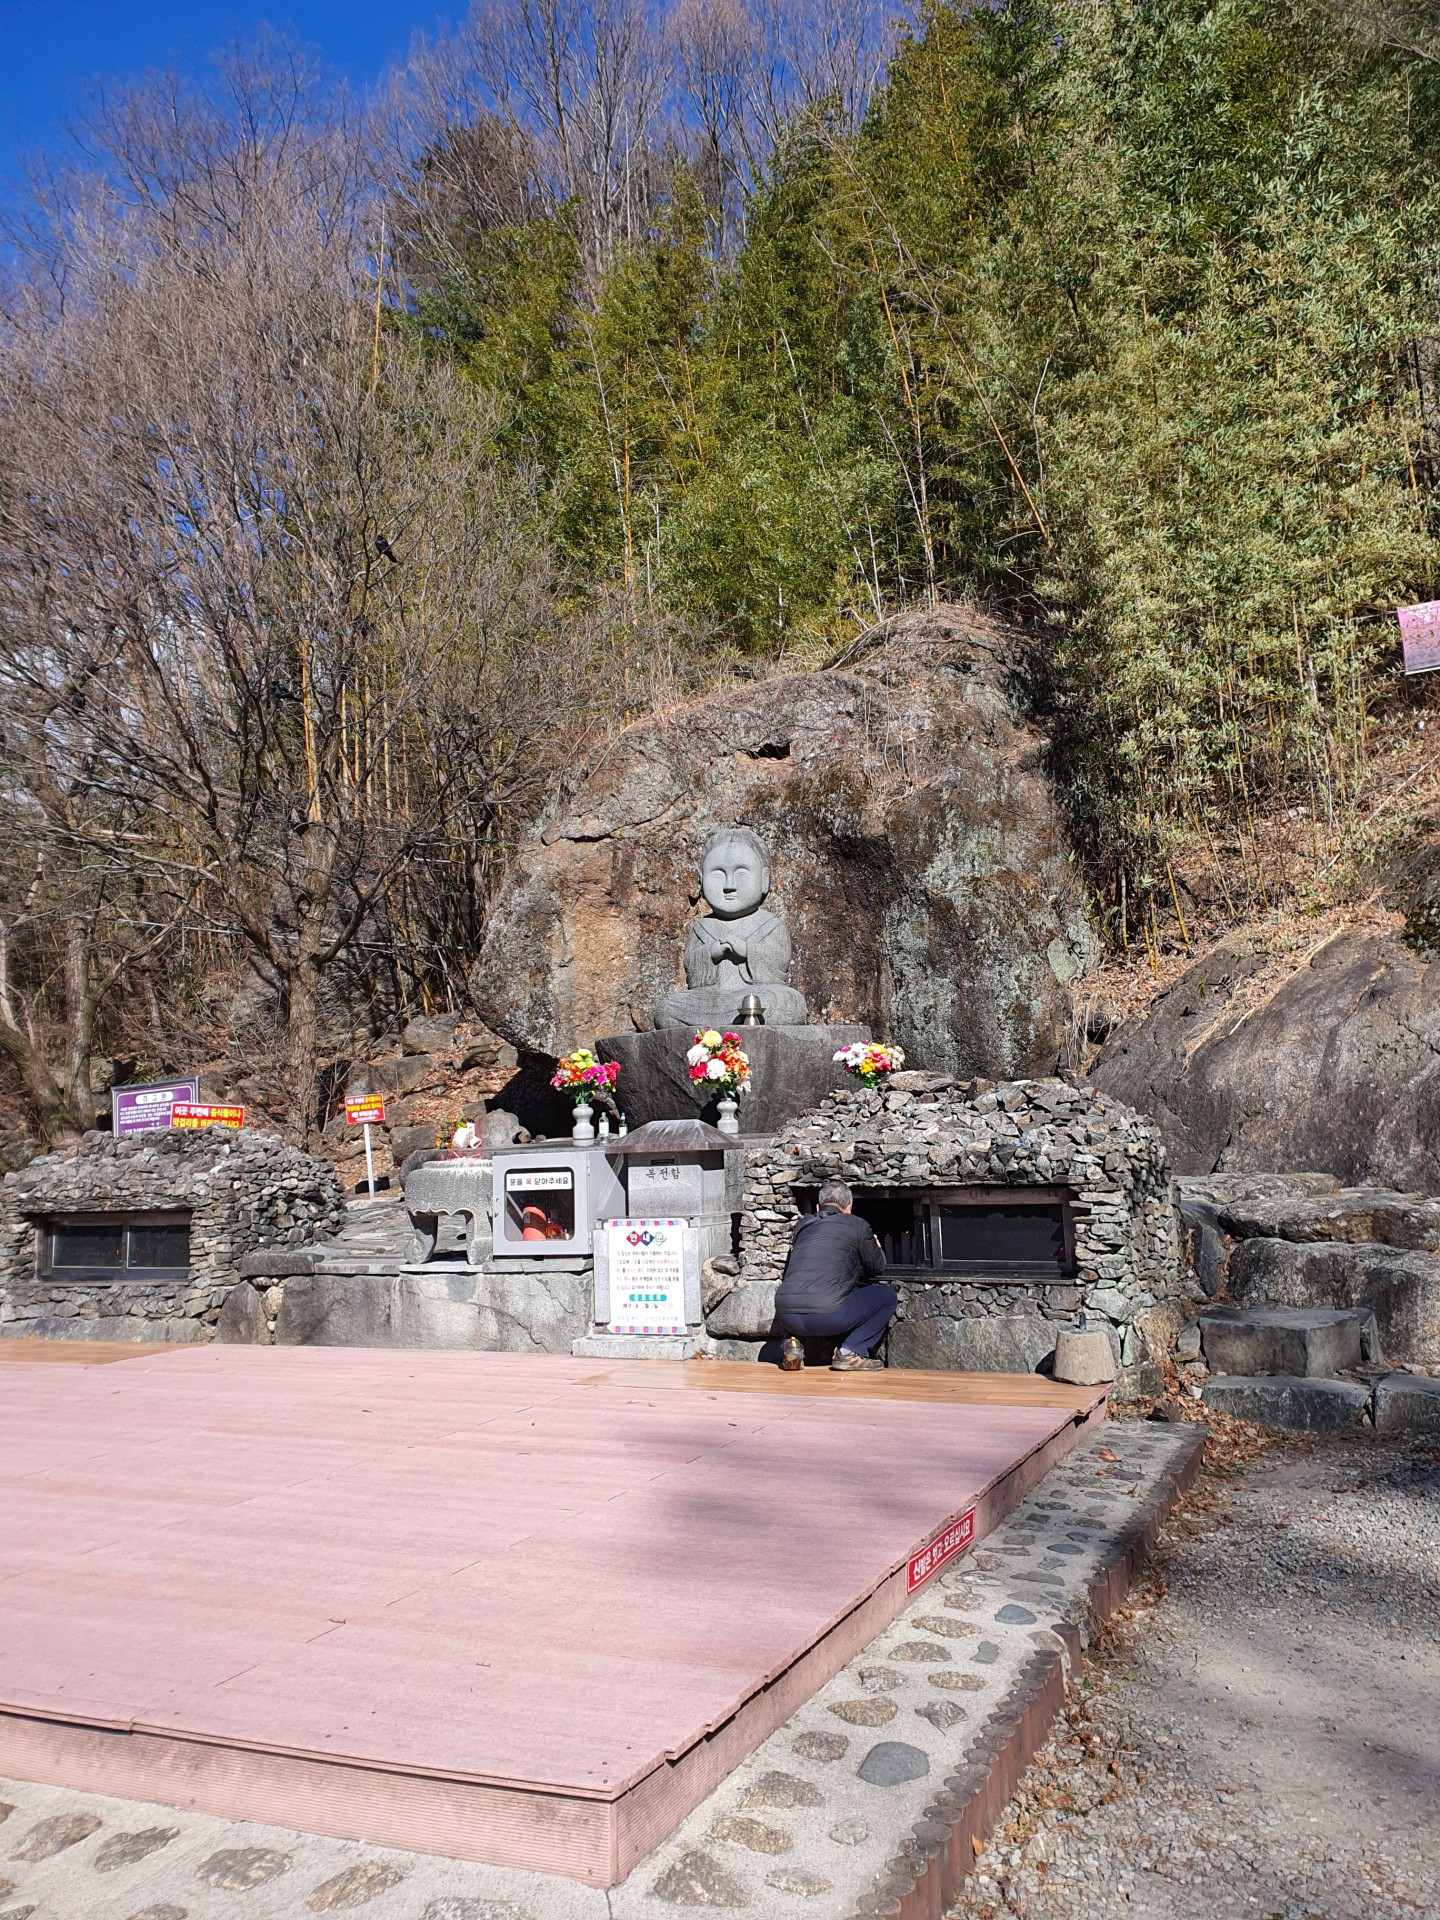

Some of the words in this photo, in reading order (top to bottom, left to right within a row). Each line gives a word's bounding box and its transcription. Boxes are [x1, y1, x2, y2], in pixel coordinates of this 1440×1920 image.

[174, 1106, 188, 1116] 이곳
[189, 1107, 209, 1117] 주변에
[210, 1108, 241, 1119] 음식물이나
[173, 1118, 199, 1127] 막걸리를
[645, 1168, 681, 1180] 복전함
[510, 1178, 523, 1186] 문을
[534, 1177, 569, 1185] 닫아주세요
[913, 1550, 931, 1581] 신발은
[932, 1541, 943, 1565] 벗고
